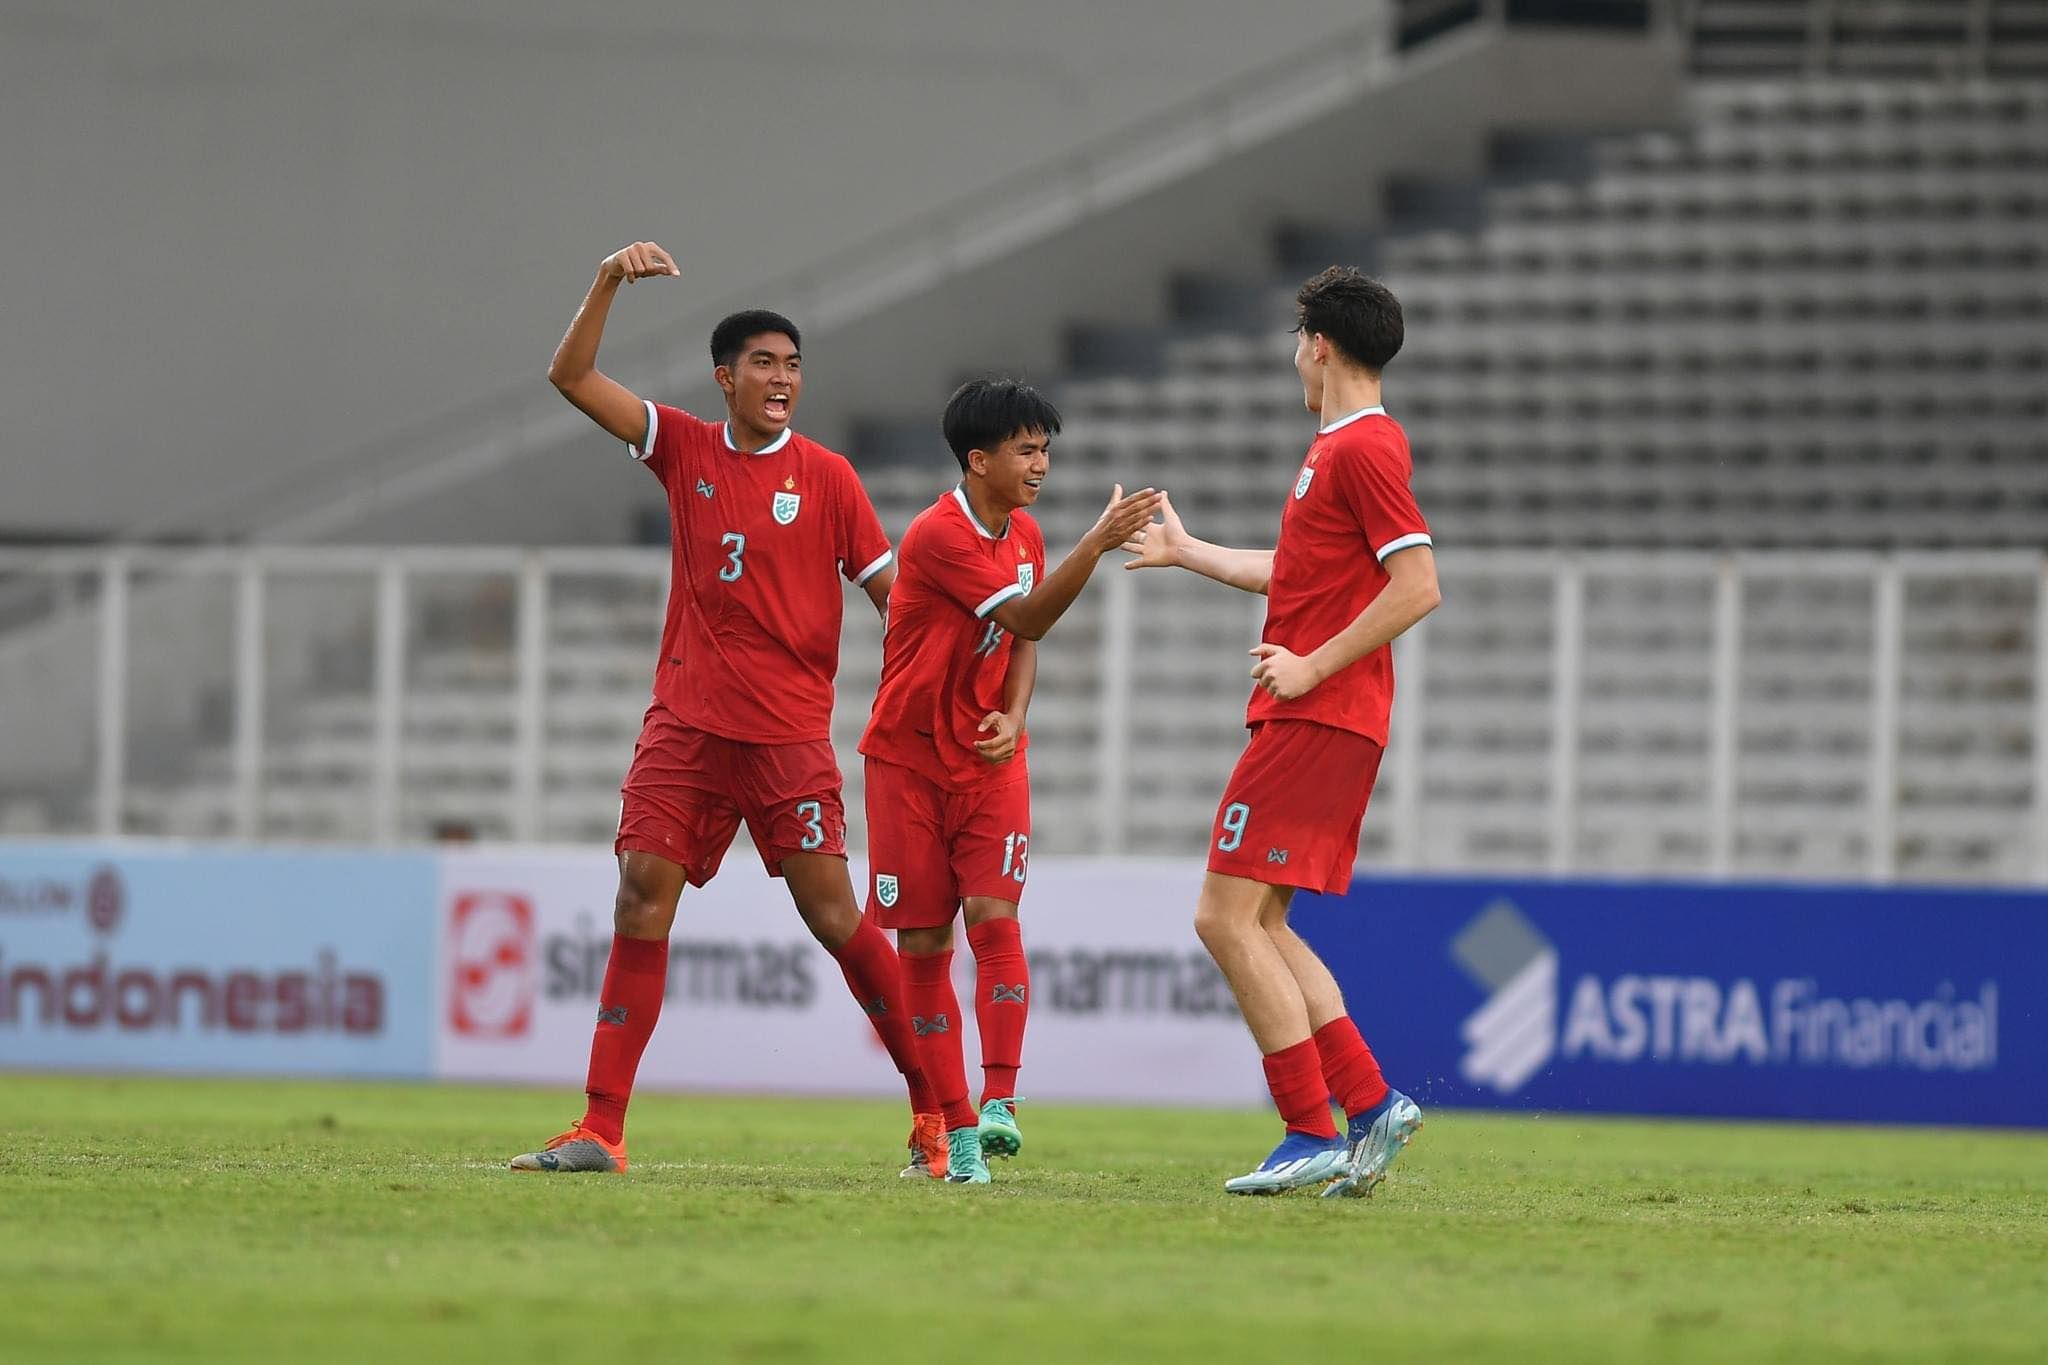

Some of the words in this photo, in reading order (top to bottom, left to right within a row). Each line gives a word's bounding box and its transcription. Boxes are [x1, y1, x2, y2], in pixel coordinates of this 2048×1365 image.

[718, 531, 746, 583] 3
[797, 799, 825, 850] 3
[1217, 802, 1250, 853] 9
[1001, 830, 1029, 883] 13
[1562, 973, 1769, 1064] ASTRA
[1769, 976, 1998, 1070] Financial
